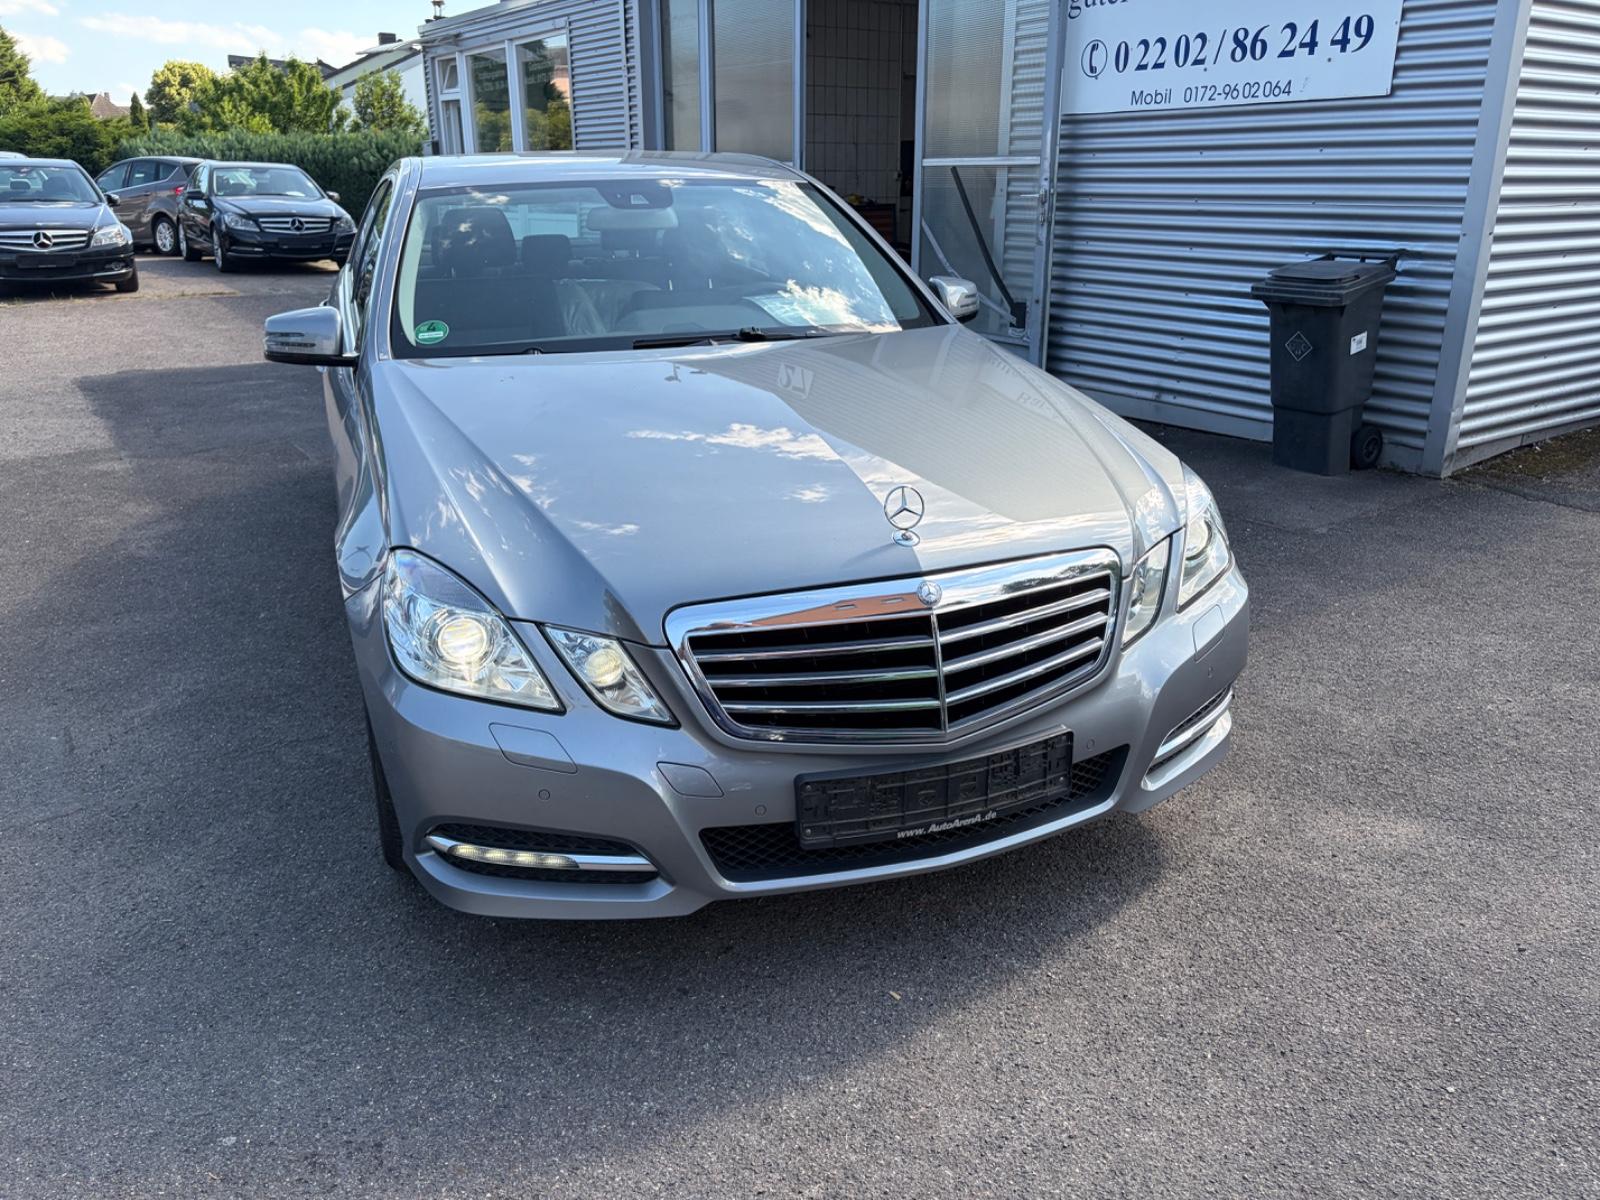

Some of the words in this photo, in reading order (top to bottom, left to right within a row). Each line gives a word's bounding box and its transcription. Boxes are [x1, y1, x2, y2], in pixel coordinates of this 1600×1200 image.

[1277, 18, 1319, 58] 24
[1329, 14, 1375, 54] 49
[1130, 88, 1172, 106] Mobil
